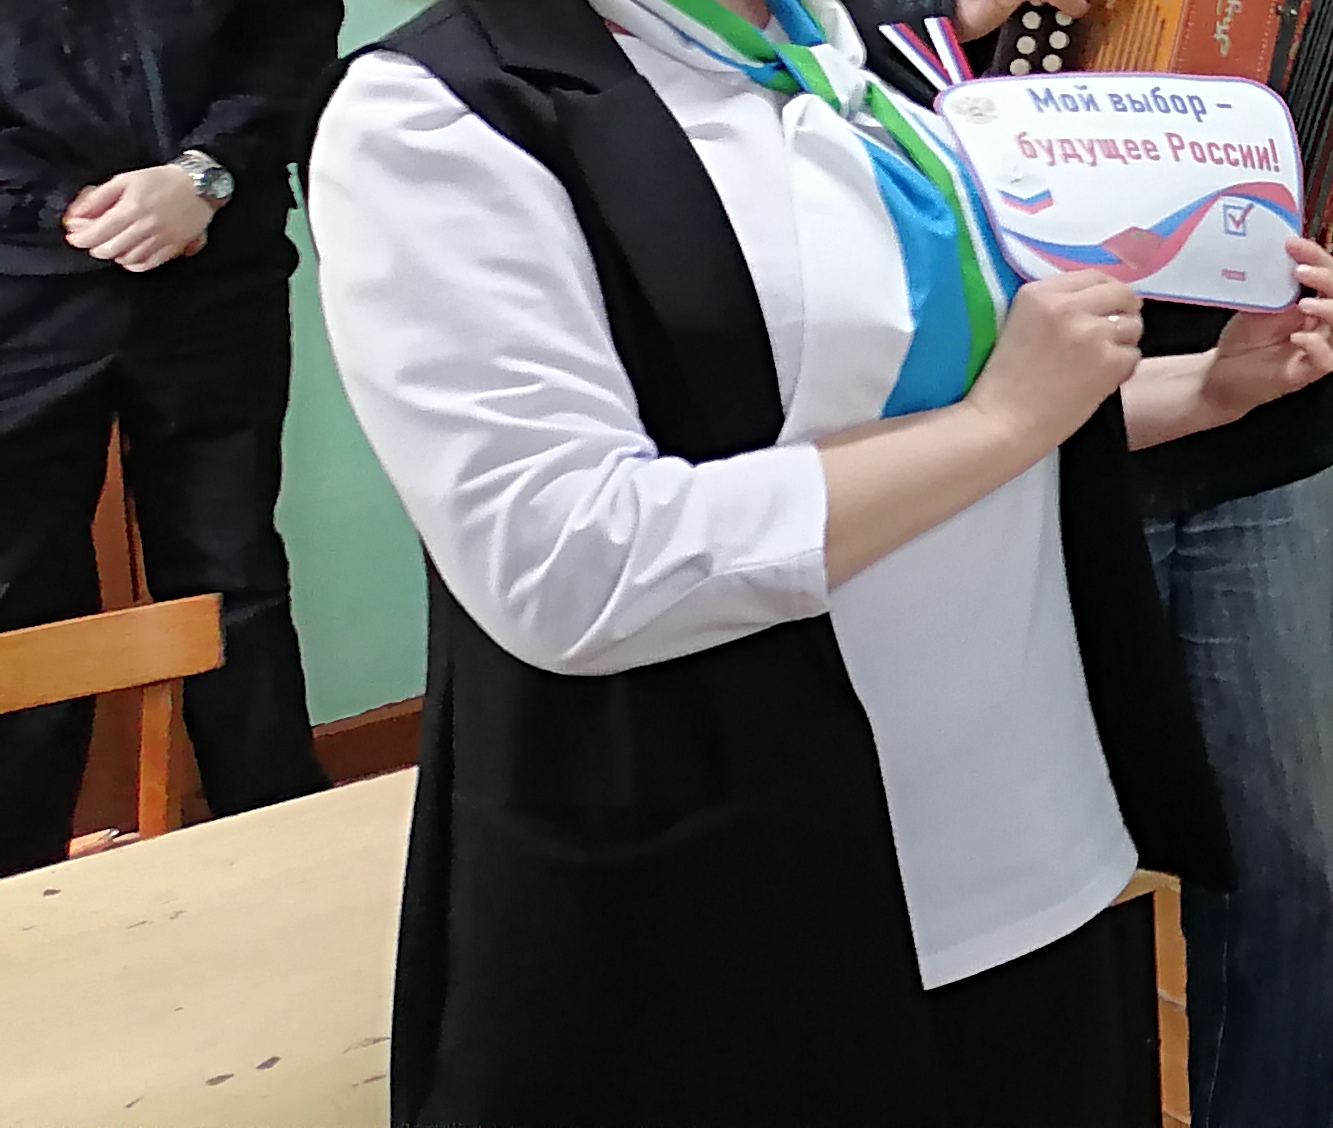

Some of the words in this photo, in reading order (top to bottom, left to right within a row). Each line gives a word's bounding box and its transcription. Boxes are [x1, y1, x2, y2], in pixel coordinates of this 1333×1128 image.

[1026, 84, 1100, 113] Мой
[1108, 87, 1207, 122] выбор
[1014, 132, 1161, 168] будущее
[1164, 133, 1280, 173] России!
